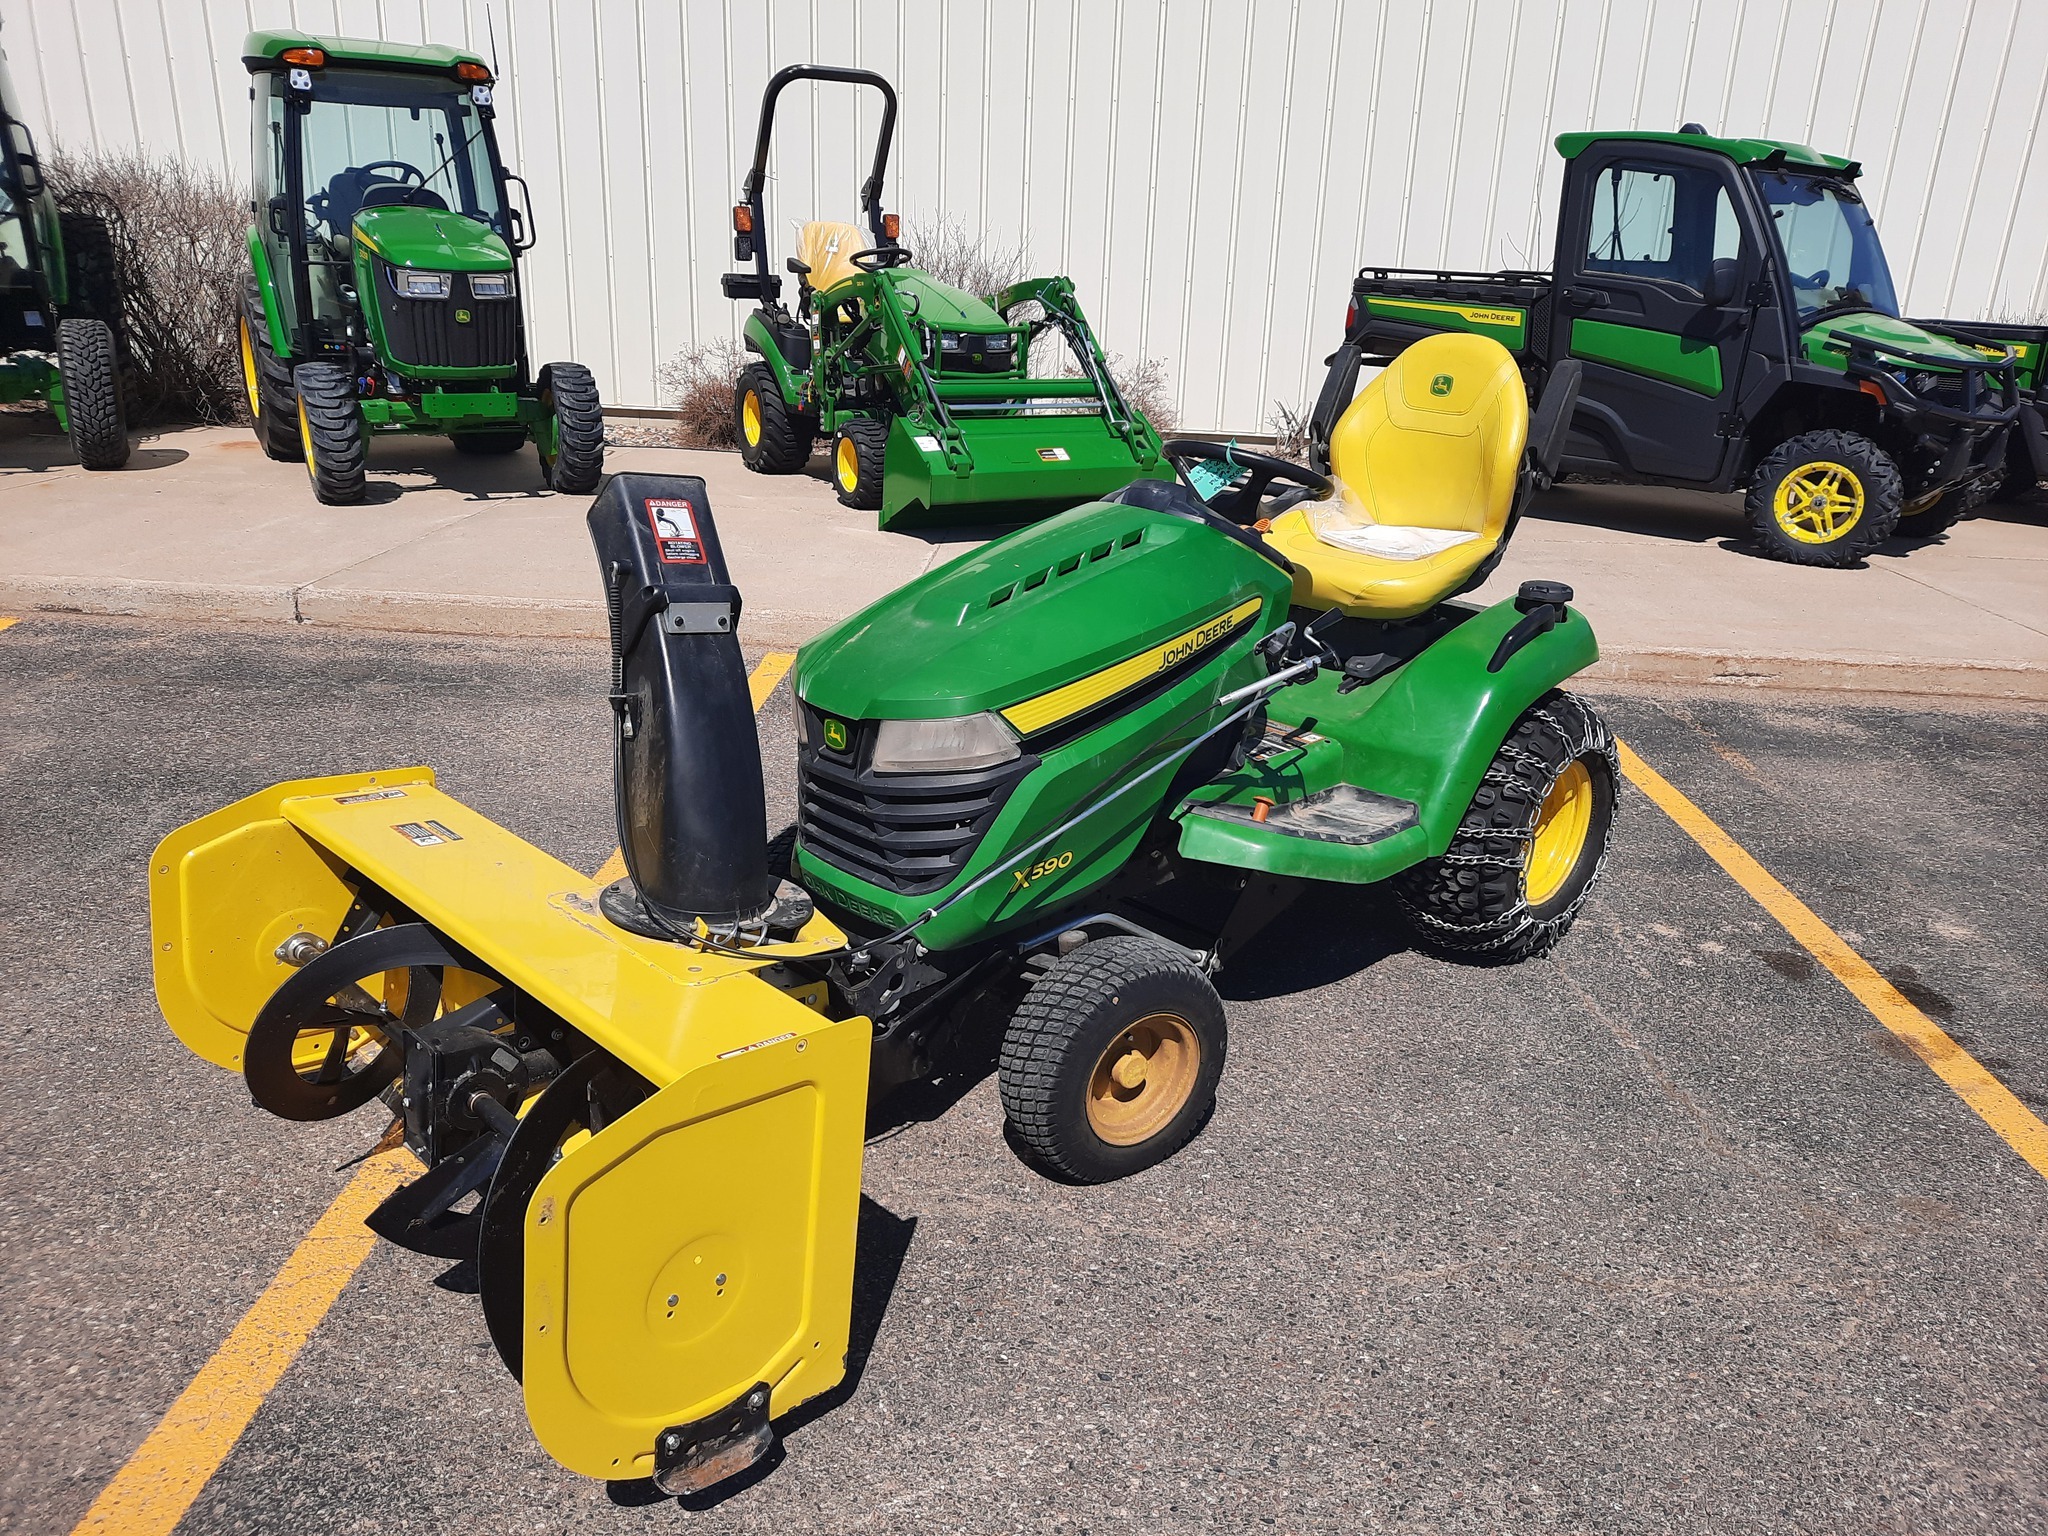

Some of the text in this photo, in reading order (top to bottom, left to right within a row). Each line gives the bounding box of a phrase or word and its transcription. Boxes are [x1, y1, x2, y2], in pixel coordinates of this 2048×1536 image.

[1491, 313, 1516, 321] DEERE
[1158, 614, 1234, 670] JOHN DEERE
[1009, 850, 1074, 894] X590
[834, 888, 897, 929] DEERE
